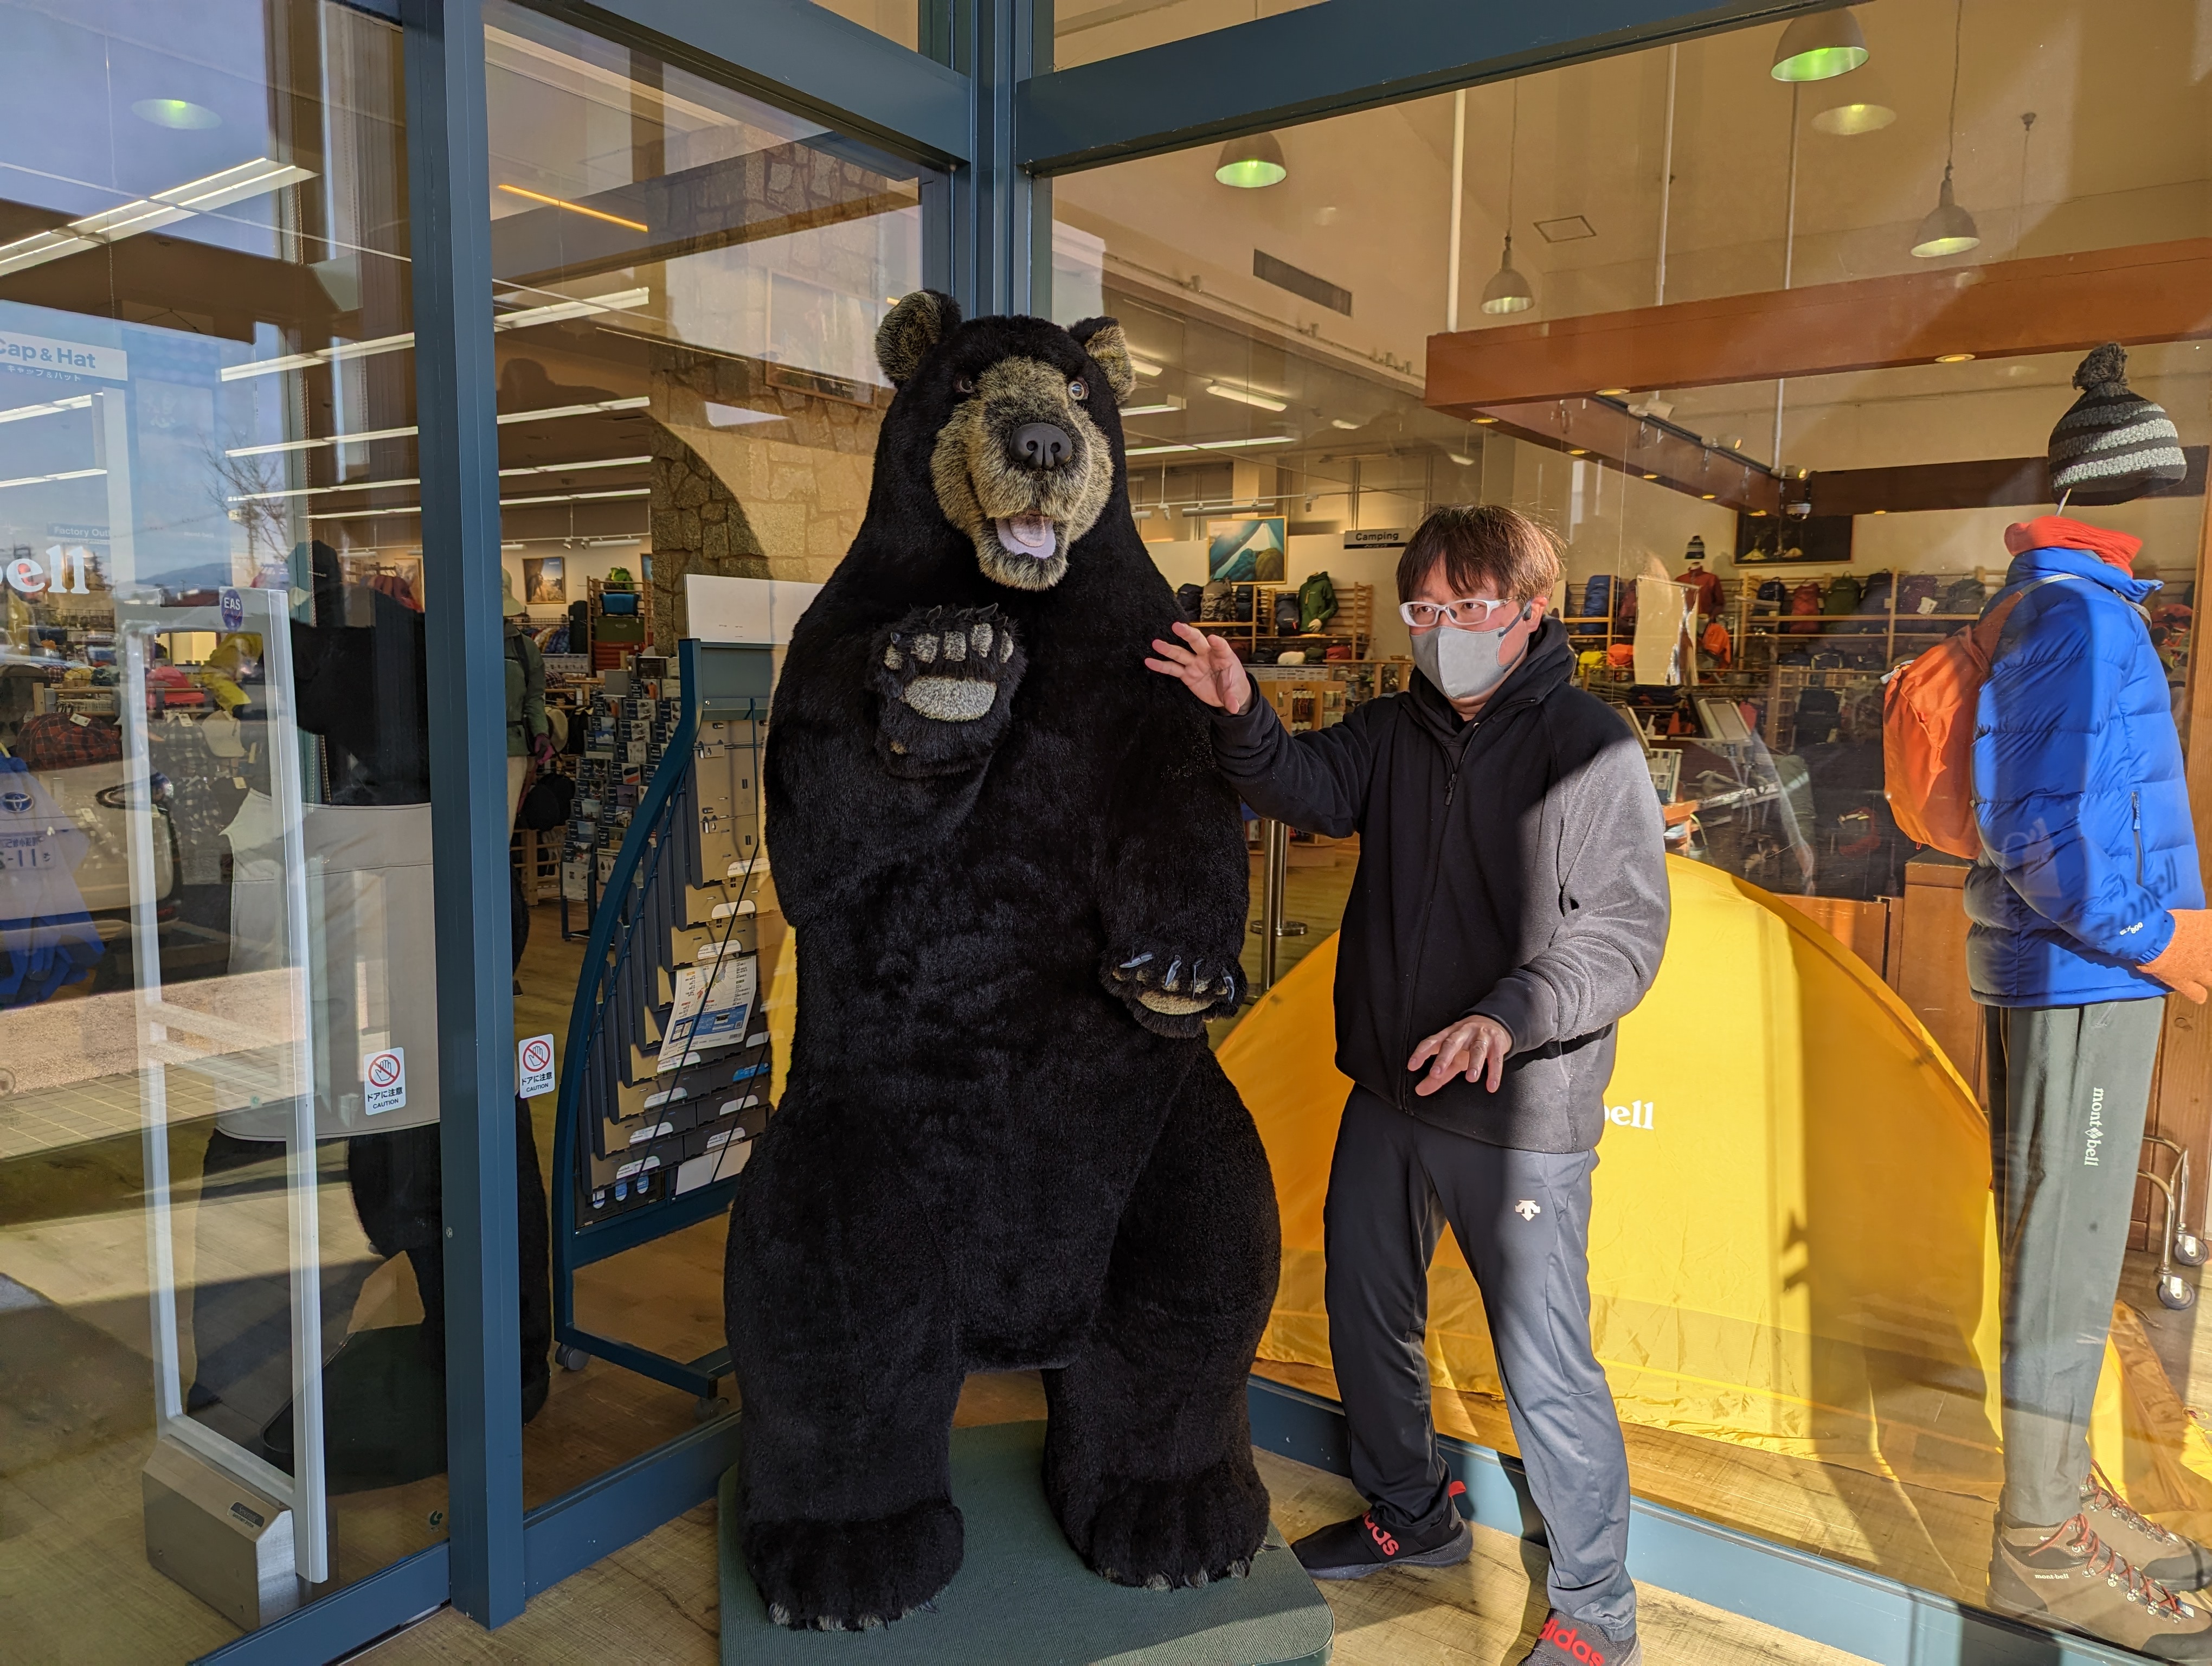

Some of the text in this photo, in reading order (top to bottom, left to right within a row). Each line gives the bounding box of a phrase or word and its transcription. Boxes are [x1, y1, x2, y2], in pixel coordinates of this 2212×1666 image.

[40, 348, 53, 362] &
[57, 348, 96, 369] Hat
[54, 526, 89, 537] Factory
[1355, 532, 1399, 541] Camping
[0, 544, 90, 594] ell
[224, 597, 241, 611] EAS
[522, 1072, 552, 1086] ドアに注意
[367, 1086, 403, 1102] ドアに注意
[526, 1083, 549, 1092] CAUTION
[372, 1098, 398, 1108] CAUTION
[1604, 1100, 1654, 1130] ell
